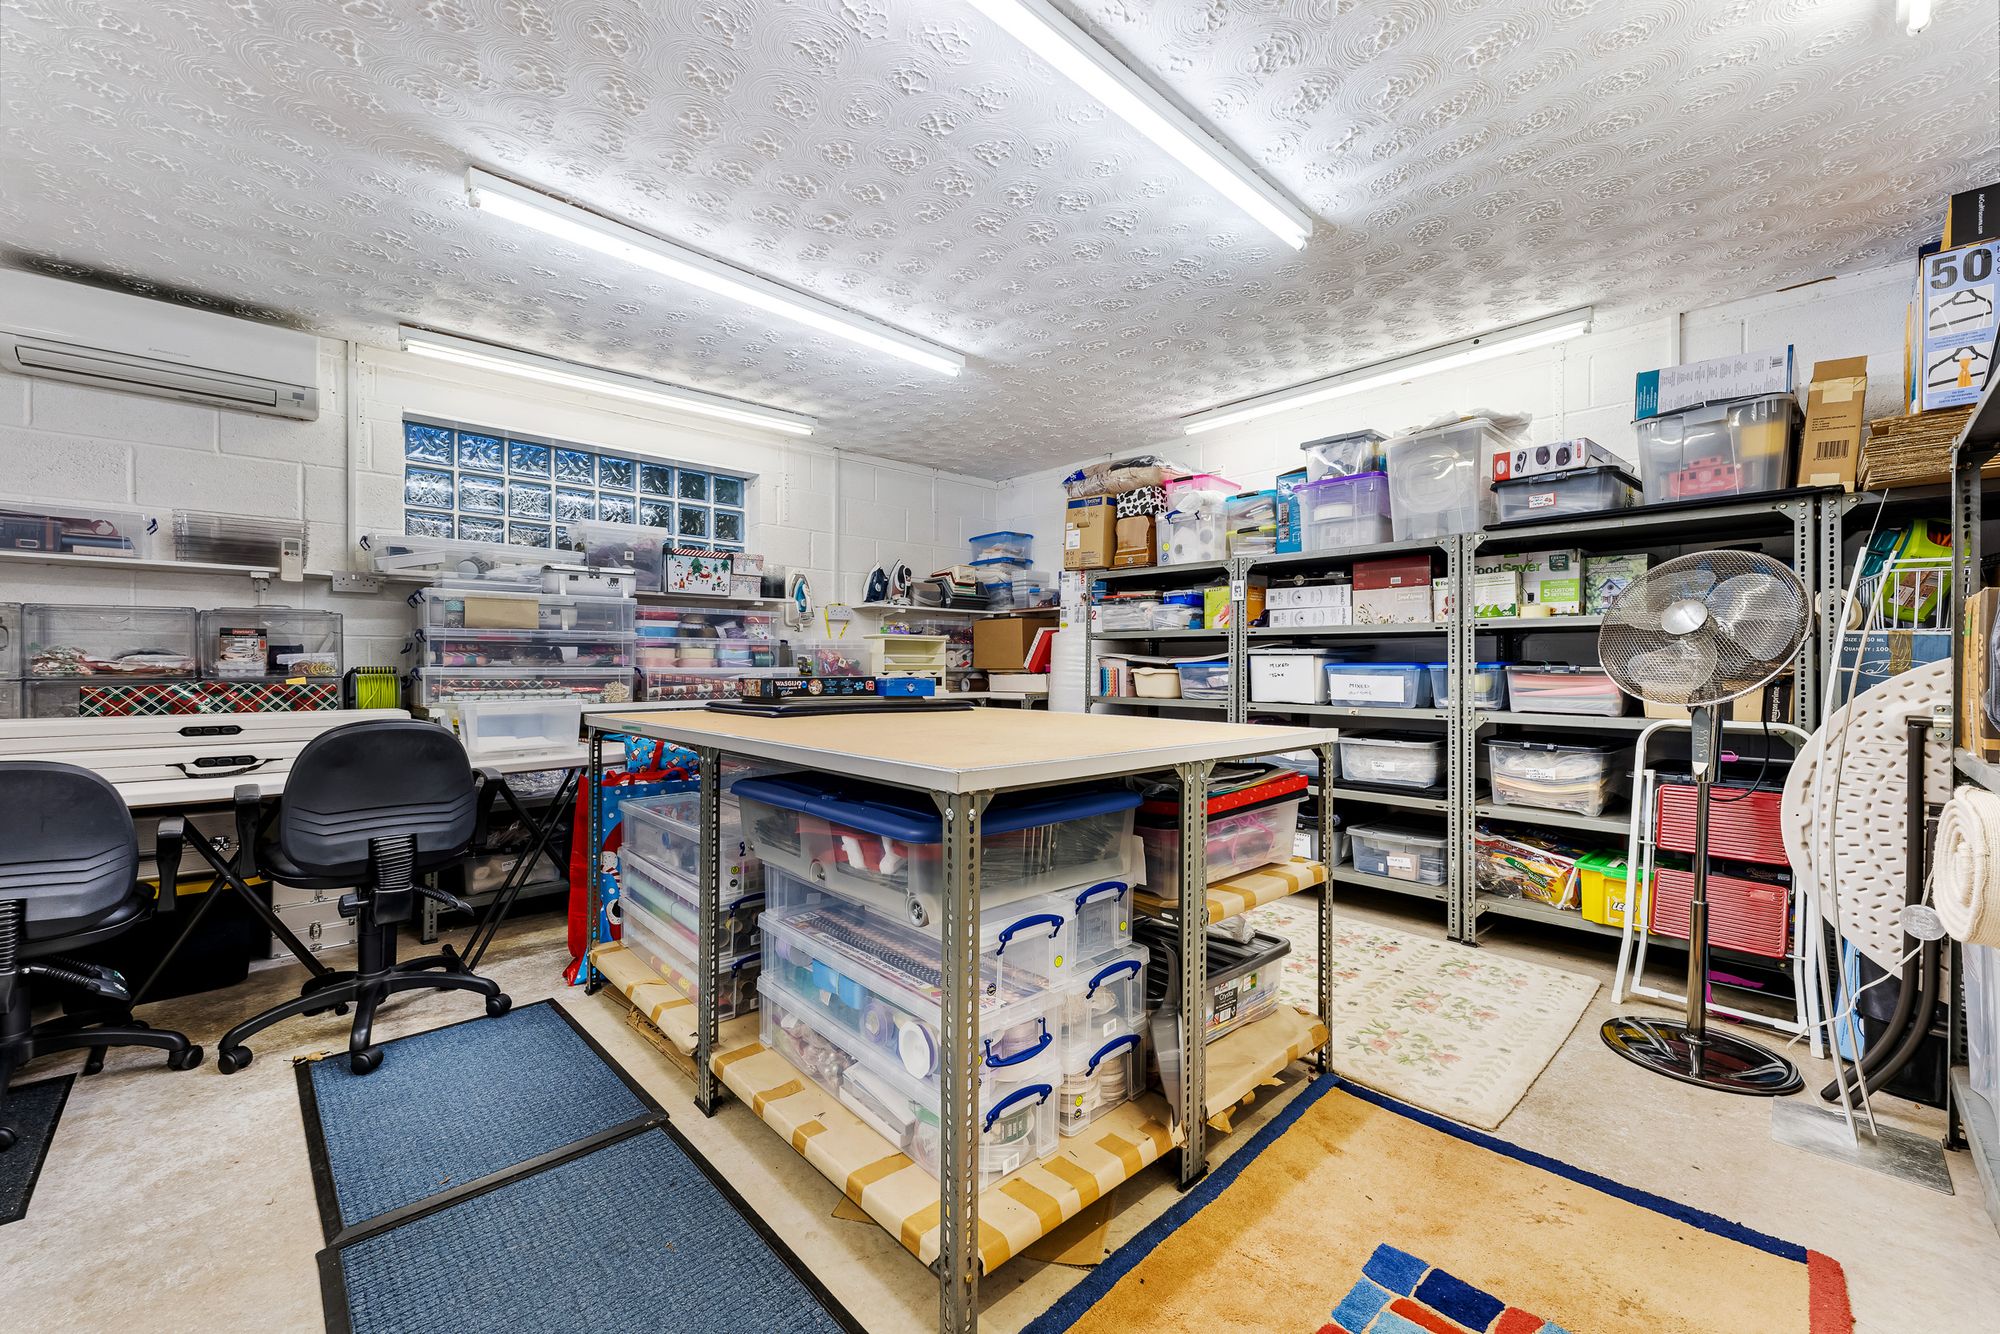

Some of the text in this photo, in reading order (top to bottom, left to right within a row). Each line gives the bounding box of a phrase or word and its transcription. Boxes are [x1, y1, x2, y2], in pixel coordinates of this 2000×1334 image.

[1930, 248, 1993, 290] 50
[1543, 588, 1550, 598] 5
[1772, 686, 1780, 703] prime
